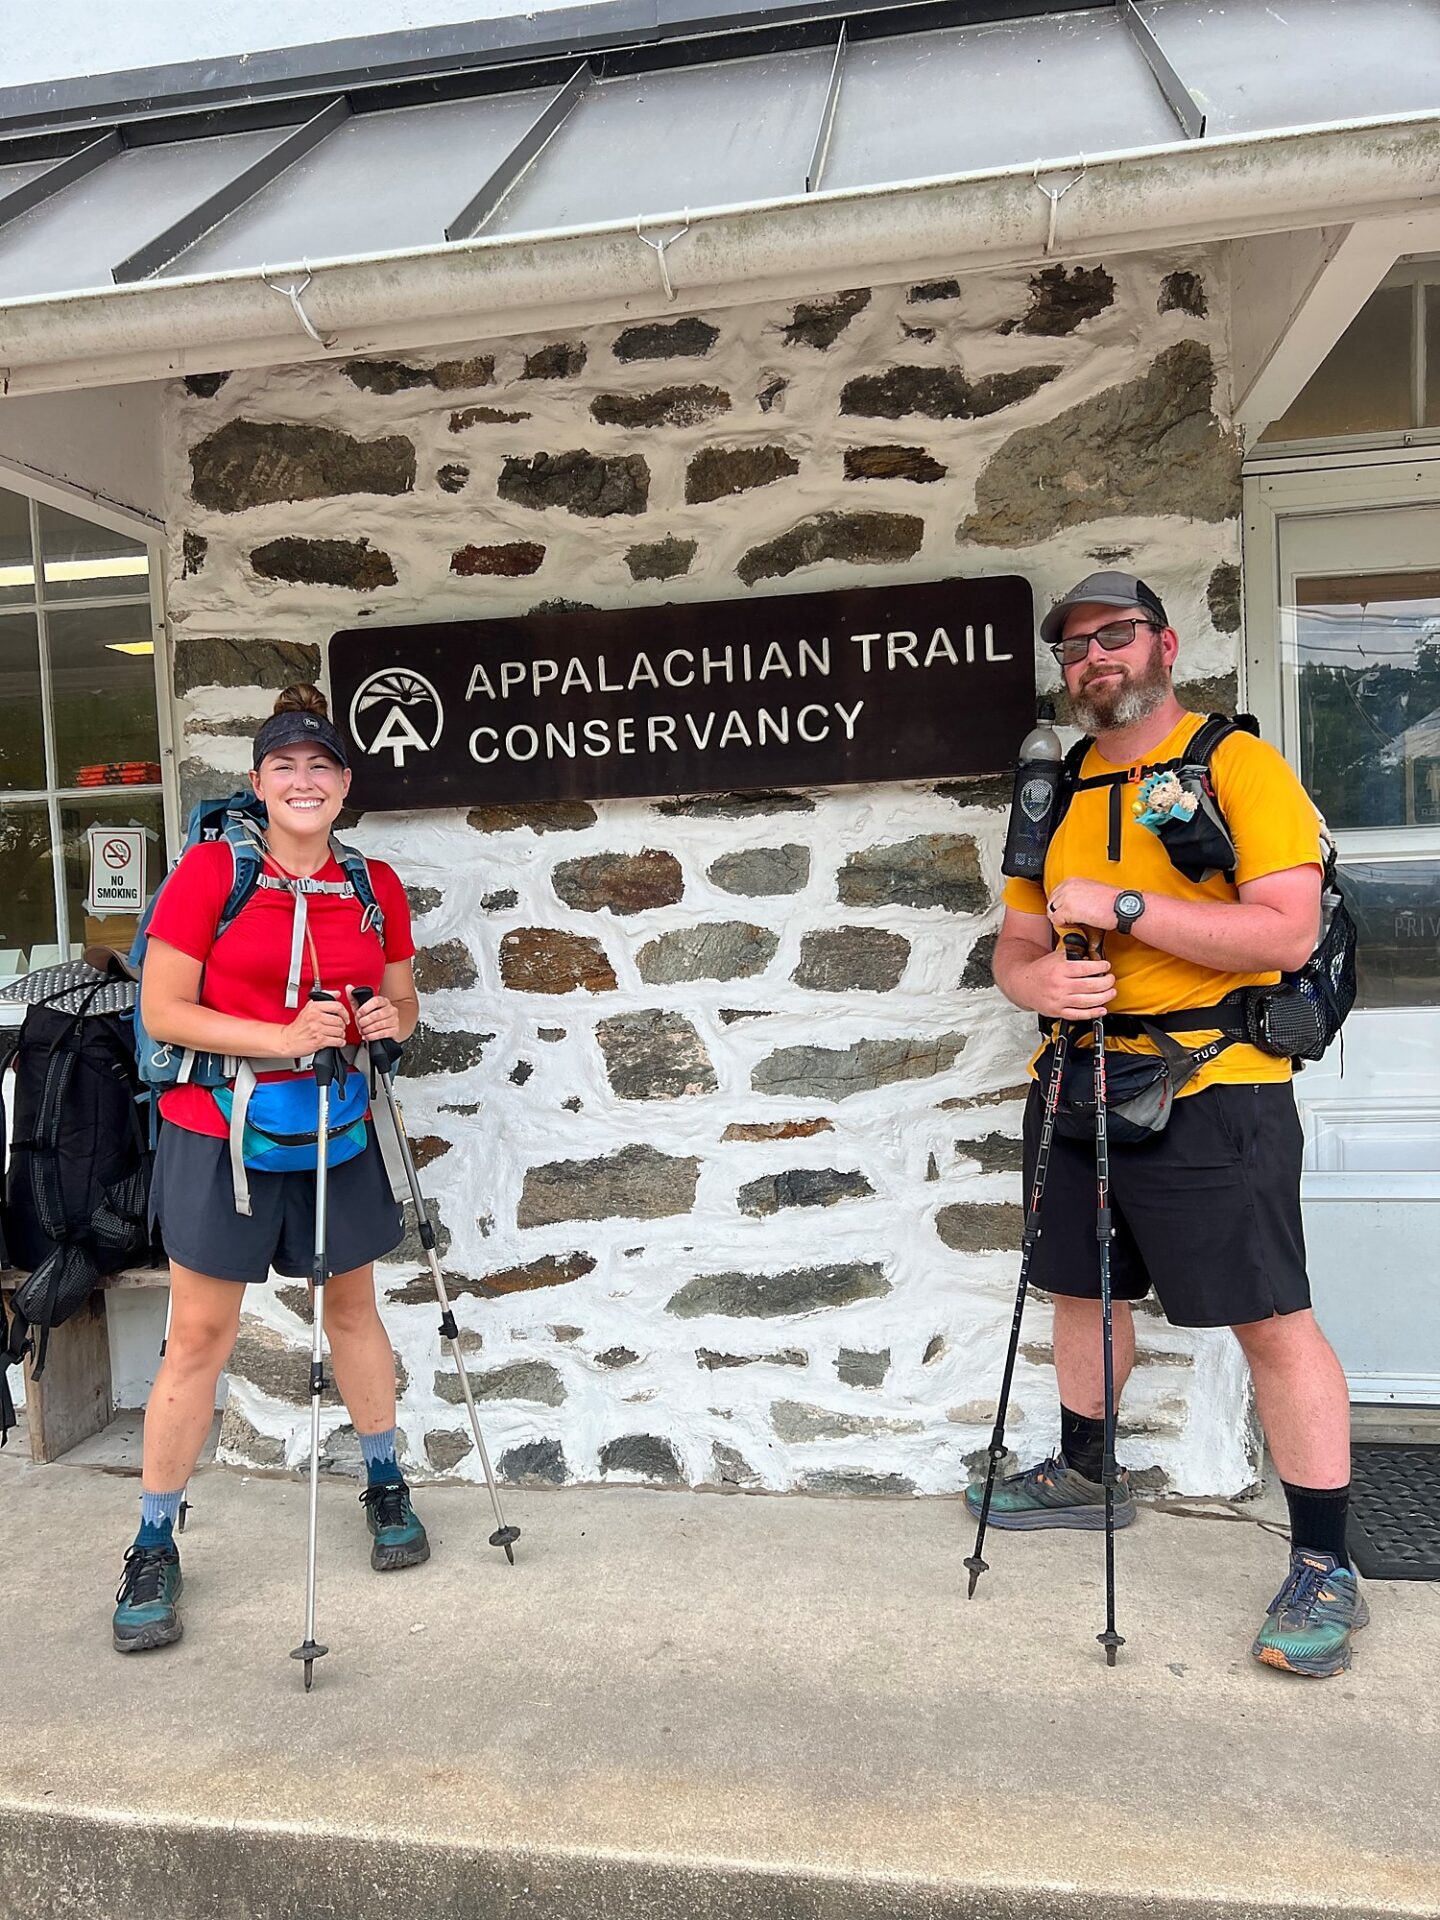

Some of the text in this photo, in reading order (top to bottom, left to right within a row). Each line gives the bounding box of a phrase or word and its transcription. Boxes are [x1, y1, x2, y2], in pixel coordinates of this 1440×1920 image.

[465, 623, 1014, 701] APPALACHIAN TRAIL
[468, 700, 864, 764] CONSERVANCY
[111, 875, 124, 886] NO
[97, 888, 138, 899] SMOKING
[1193, 1045, 1218, 1062] TUG
